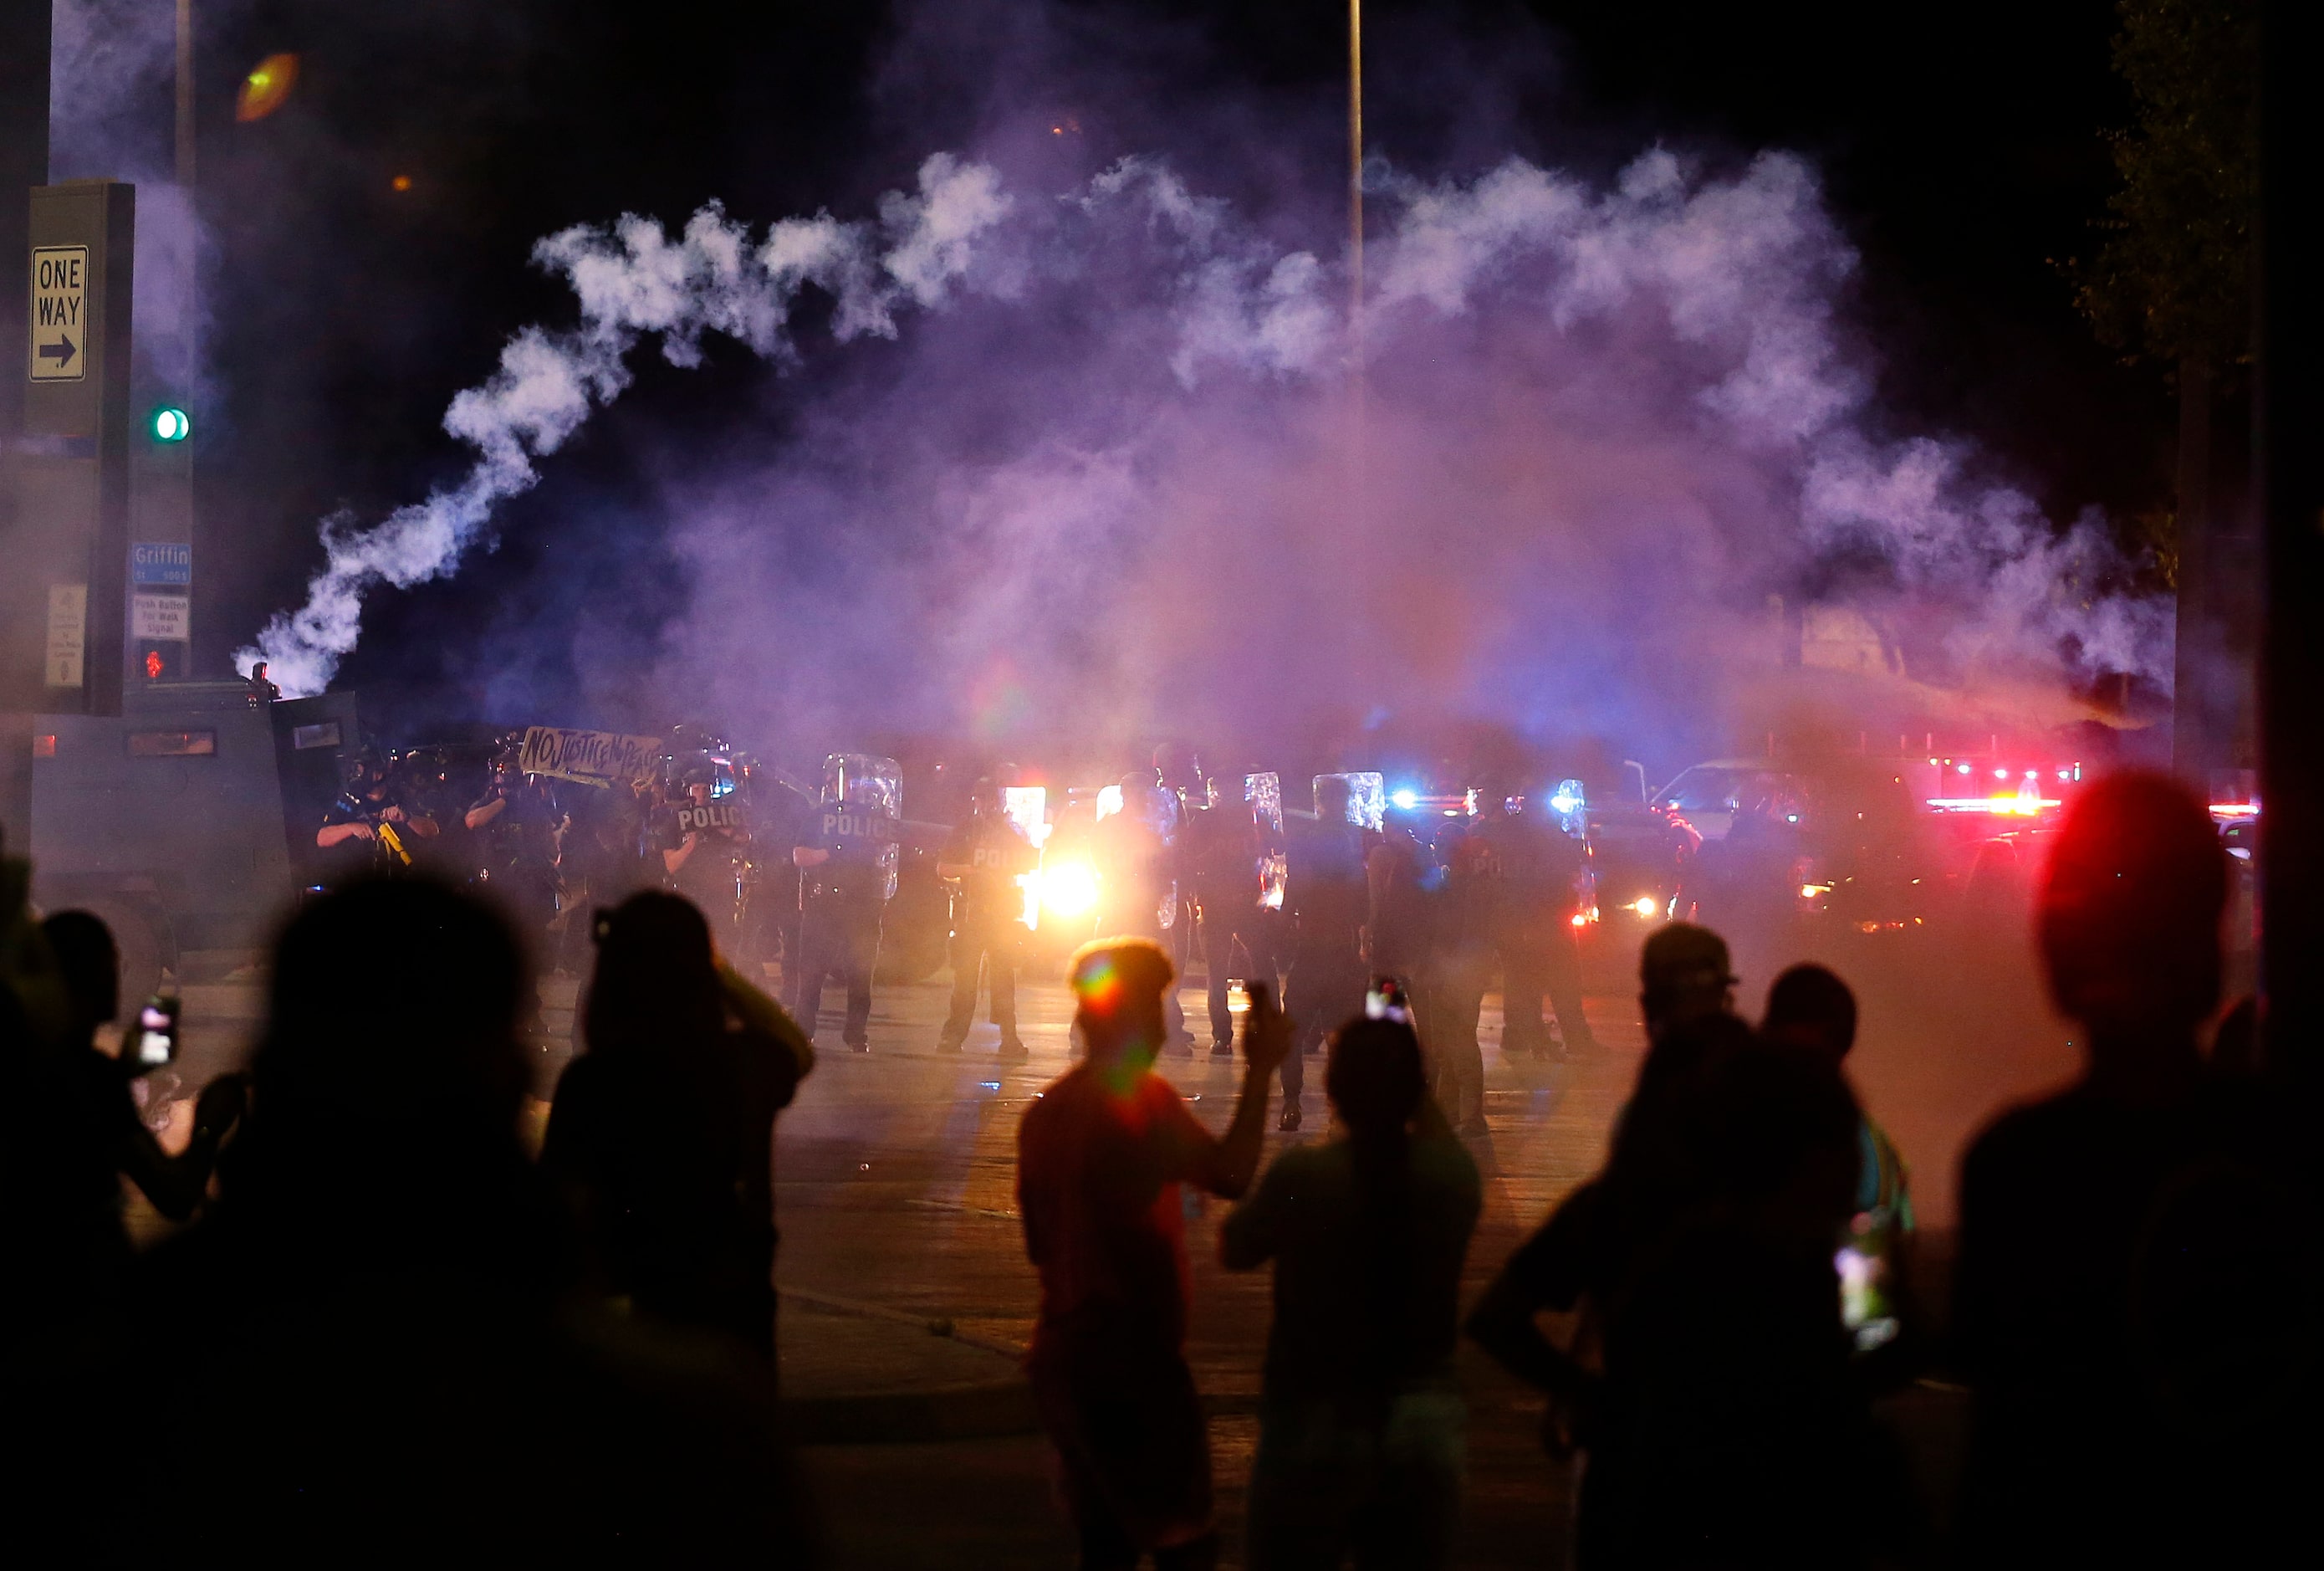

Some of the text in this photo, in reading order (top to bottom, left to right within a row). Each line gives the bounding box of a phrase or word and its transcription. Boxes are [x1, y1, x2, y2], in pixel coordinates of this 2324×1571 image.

[40, 259, 80, 289] ONE
[38, 296, 81, 326] WAY
[135, 546, 189, 564] Griffin
[135, 599, 187, 610] Push Button
[159, 612, 179, 622] Walk
[147, 622, 174, 635] Signal
[523, 728, 554, 769] NO
[551, 729, 609, 770] JUSTICE
